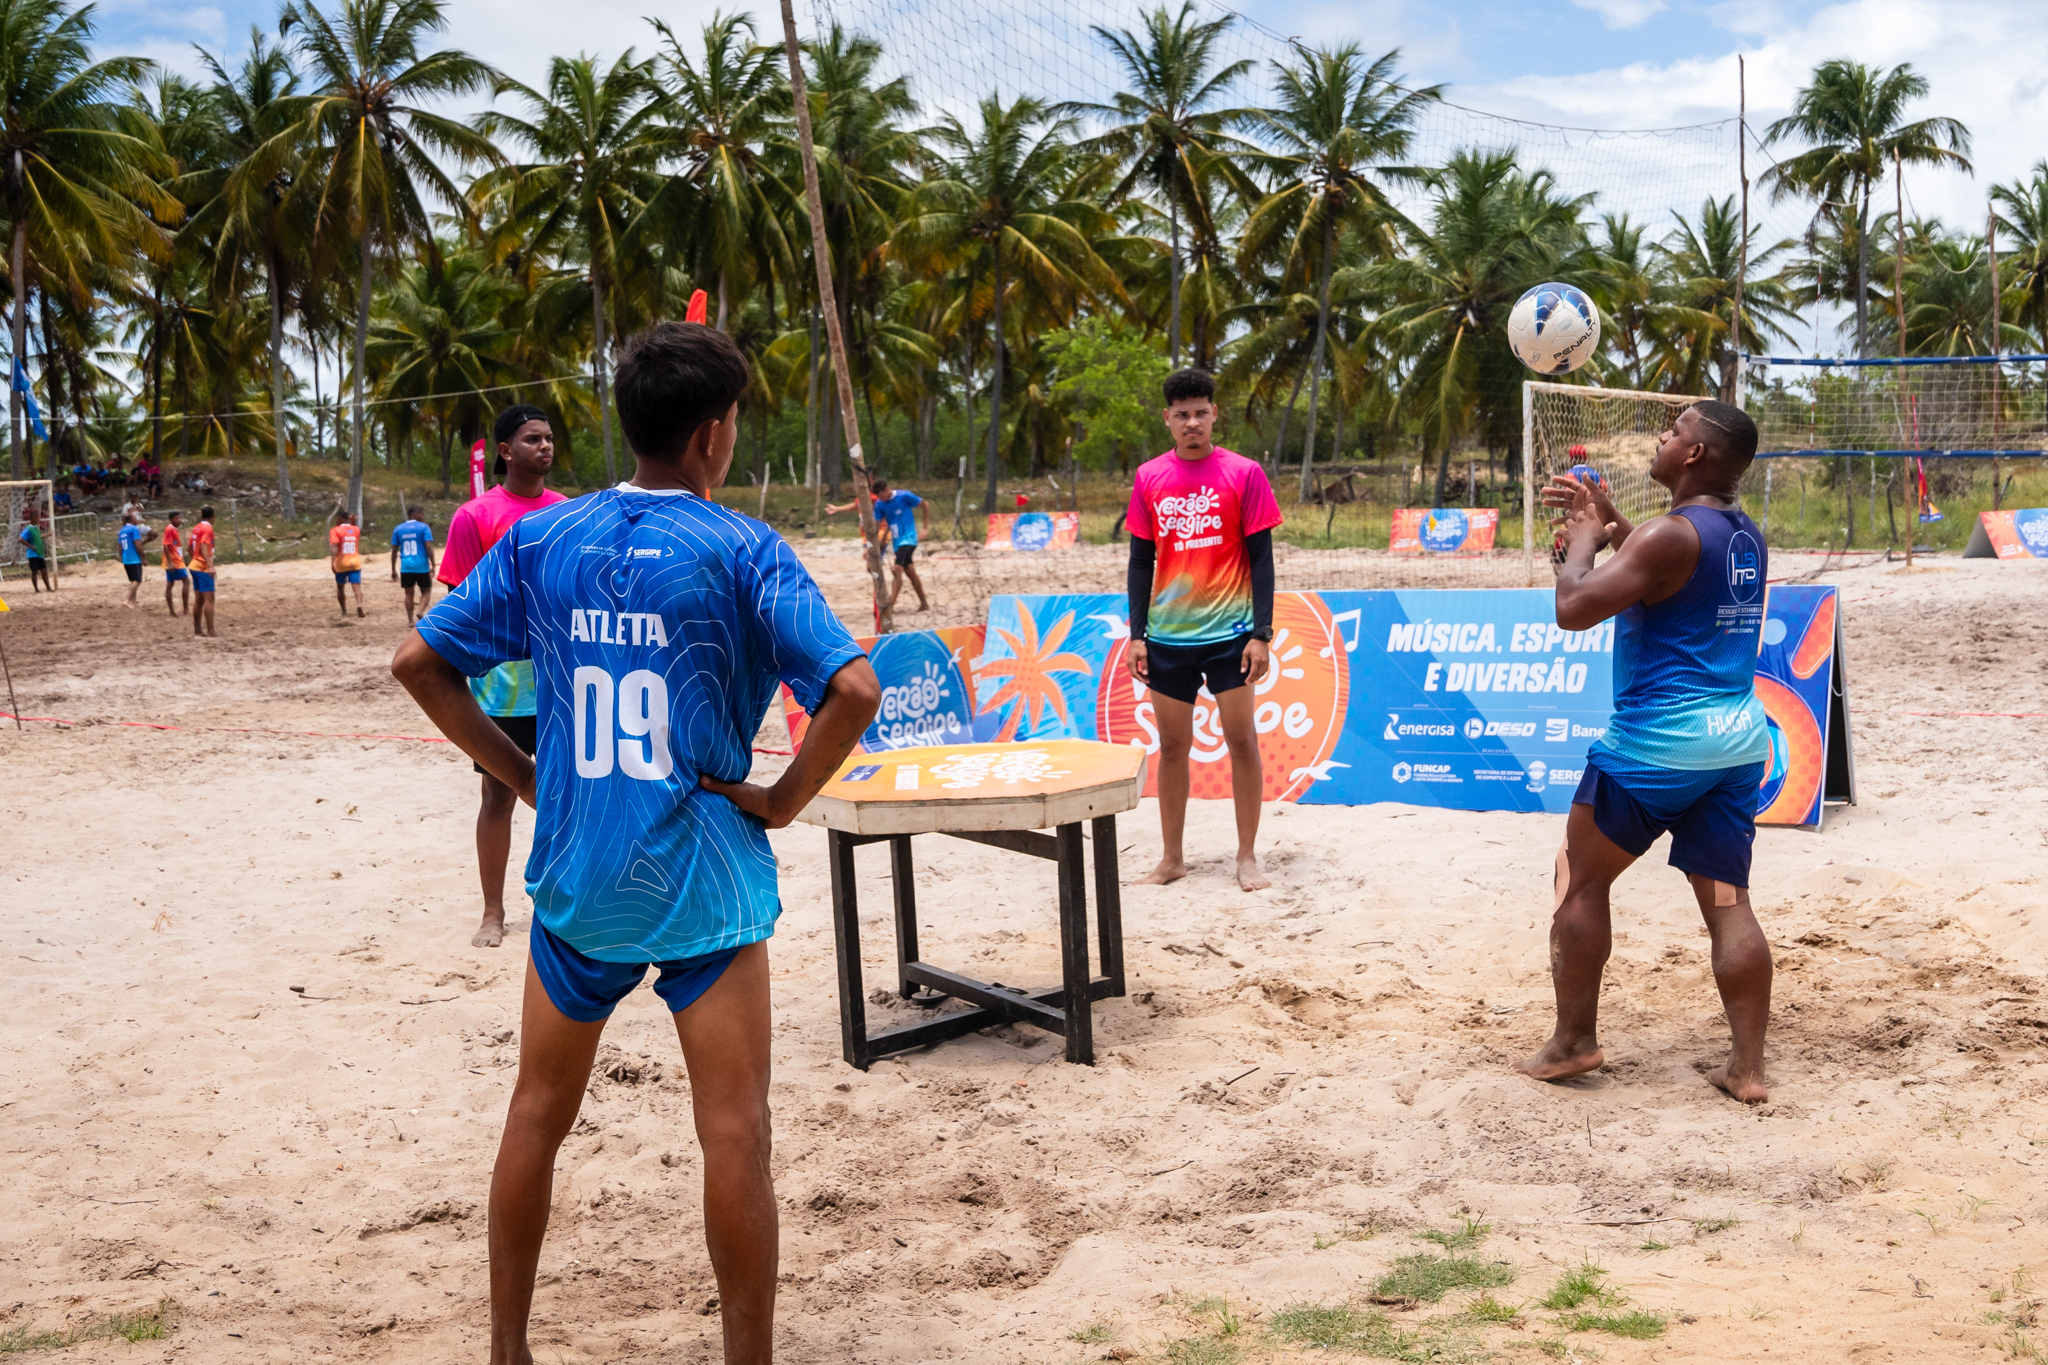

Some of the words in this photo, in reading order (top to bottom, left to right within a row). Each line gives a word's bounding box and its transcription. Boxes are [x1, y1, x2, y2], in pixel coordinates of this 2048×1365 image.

[1553, 318, 1597, 360] PENALTY
[570, 609, 669, 647] ATLETA
[1386, 618, 1503, 654] MÚSICA,
[1509, 623, 1615, 653] ESPORT
[1424, 662, 1442, 692] E
[1445, 657, 1588, 693] DIVERSÃO
[574, 666, 674, 781] 09
[1398, 724, 1455, 736] energisa
[1484, 721, 1537, 737] DESO
[1571, 724, 1606, 737] Bane
[1413, 764, 1451, 773] FUNCAP
[1549, 769, 1584, 780] SERG
